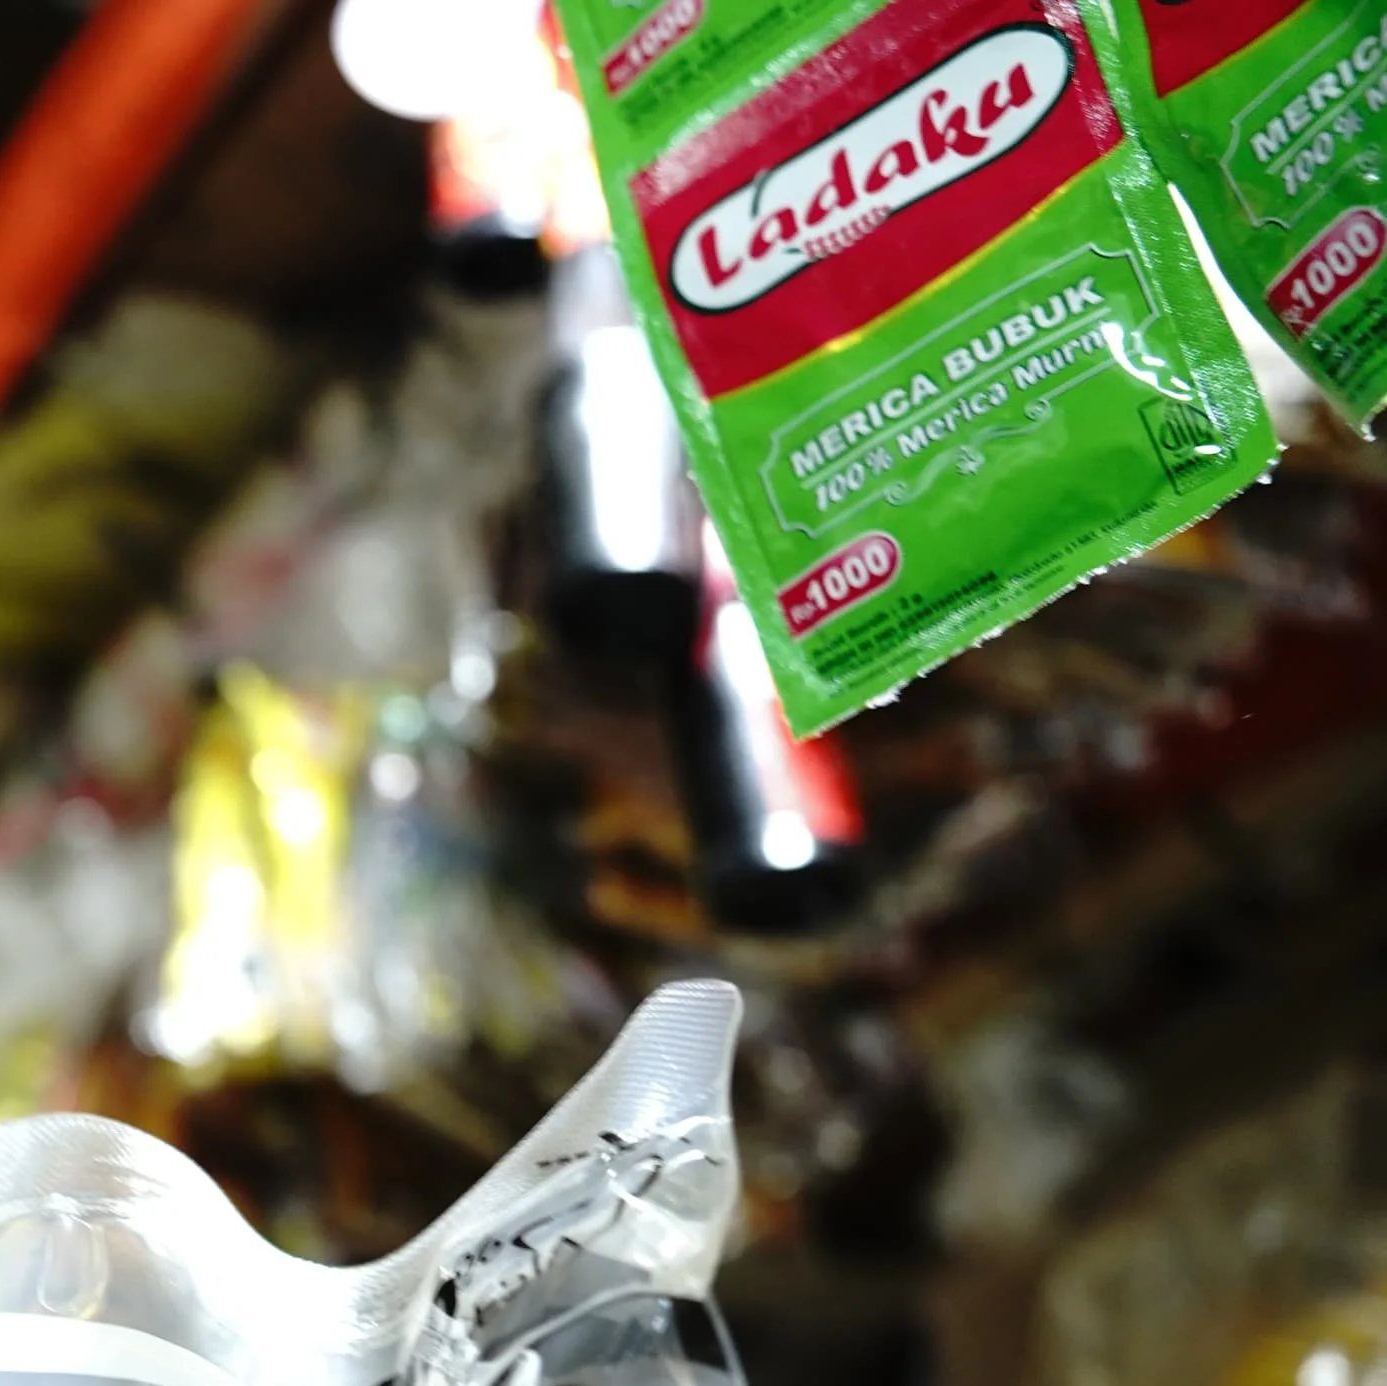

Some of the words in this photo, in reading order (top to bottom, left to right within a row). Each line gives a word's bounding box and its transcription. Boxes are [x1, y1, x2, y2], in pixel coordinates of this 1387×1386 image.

[697, 63, 1035, 288] Ladaku
[789, 373, 940, 480] MERICA
[942, 276, 1105, 382] BUBUK
[814, 446, 894, 512] 100%
[896, 380, 1009, 459] Merica
[1011, 326, 1113, 391] Murn
